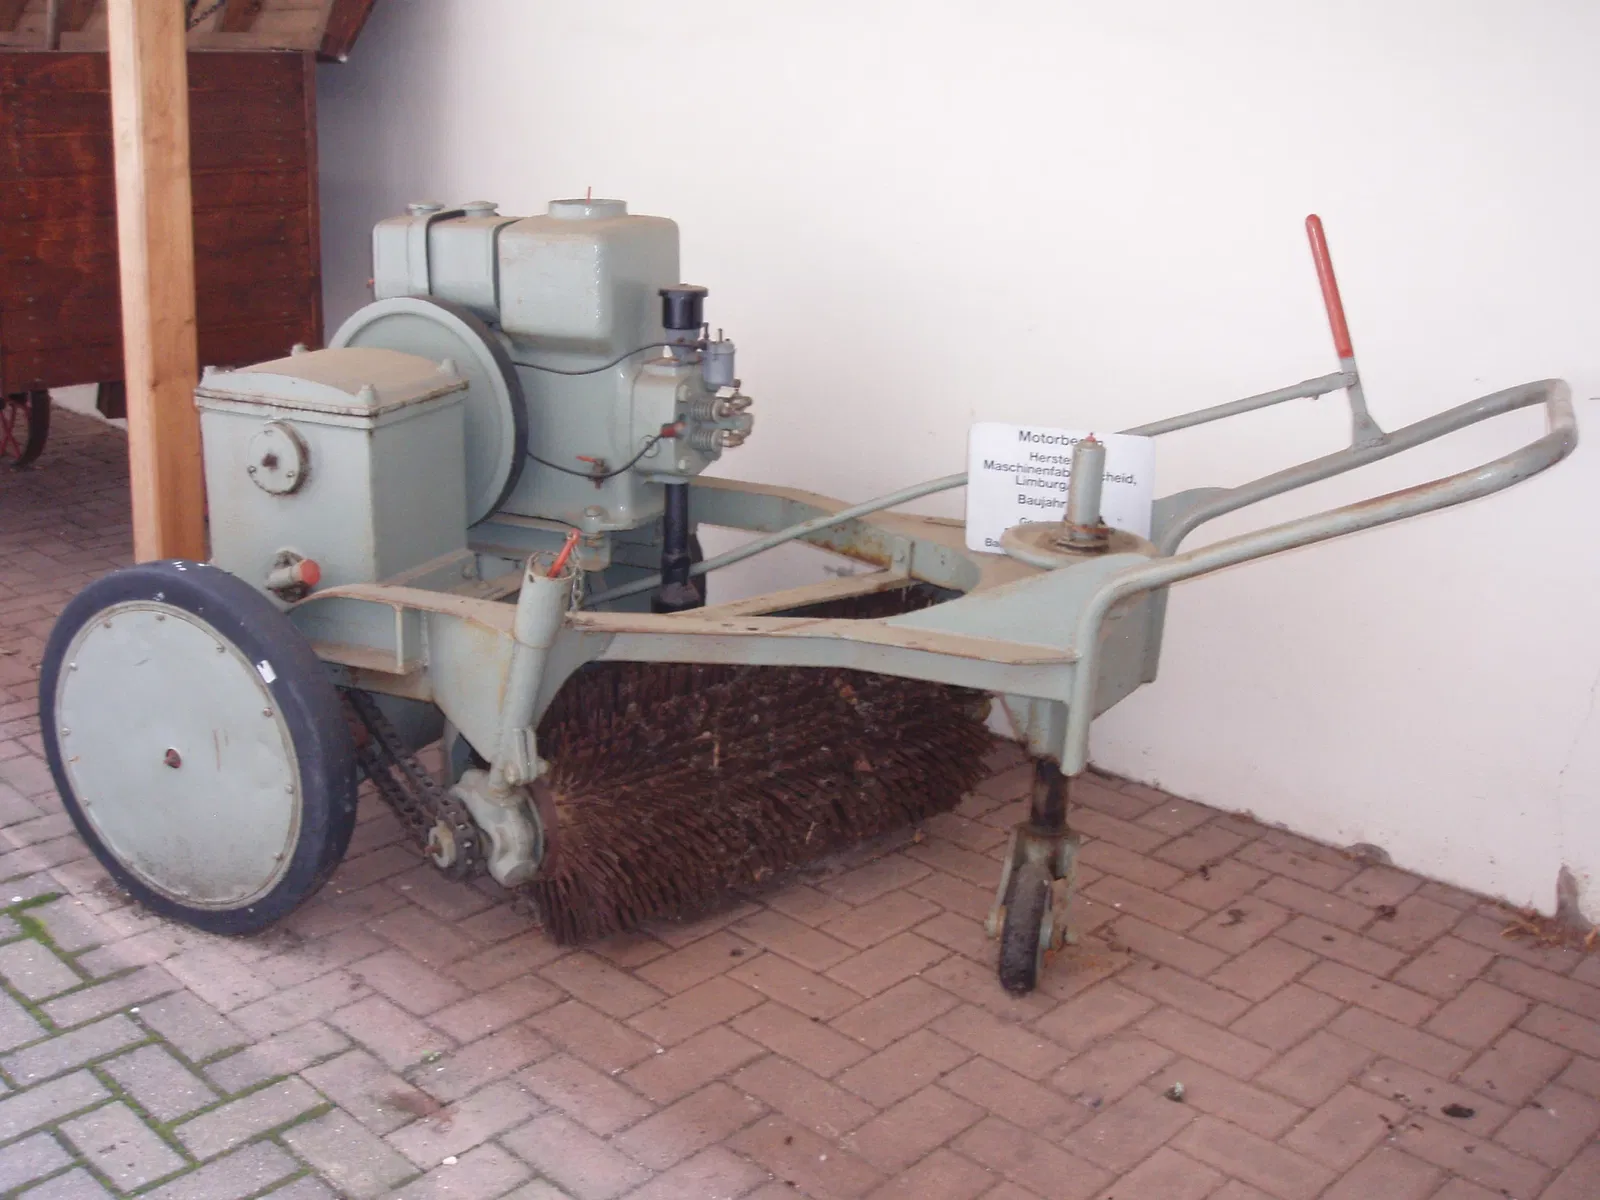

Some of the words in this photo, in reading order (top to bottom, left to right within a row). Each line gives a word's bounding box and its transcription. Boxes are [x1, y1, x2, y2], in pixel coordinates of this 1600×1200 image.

[1018, 430, 1103, 447] Motorben
[1029, 452, 1072, 465] Herste
[983, 459, 1071, 478] Maschinenfab
[1101, 471, 1137, 486] cheid,
[1015, 475, 1069, 492] Limburg
